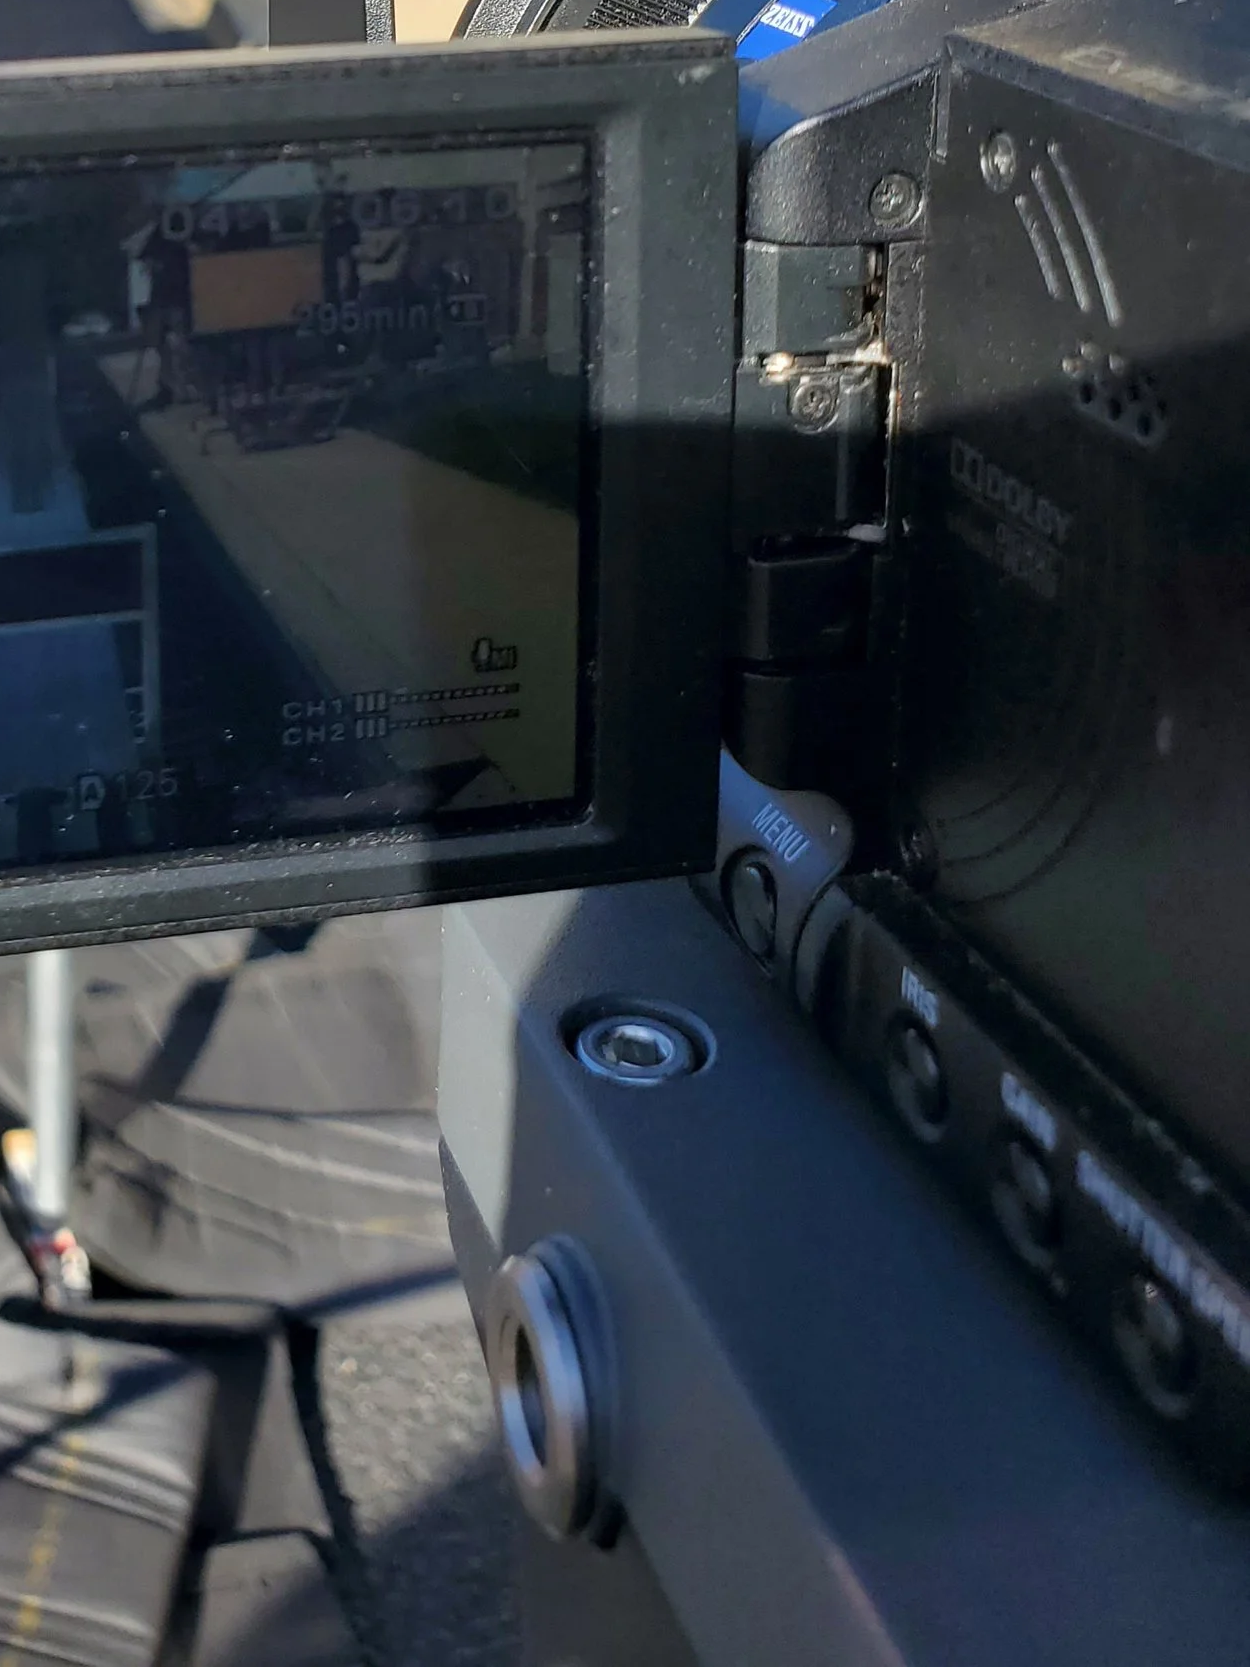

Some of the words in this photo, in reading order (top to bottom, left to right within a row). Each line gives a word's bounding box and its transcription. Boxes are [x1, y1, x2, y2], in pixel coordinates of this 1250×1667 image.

[760, 4, 816, 38] ZEISS
[281, 697, 343, 719] CH1
[281, 724, 346, 747] CH2
[119, 766, 179, 800] 125
[752, 800, 813, 865] MENU
[901, 965, 940, 1028] IRIS
